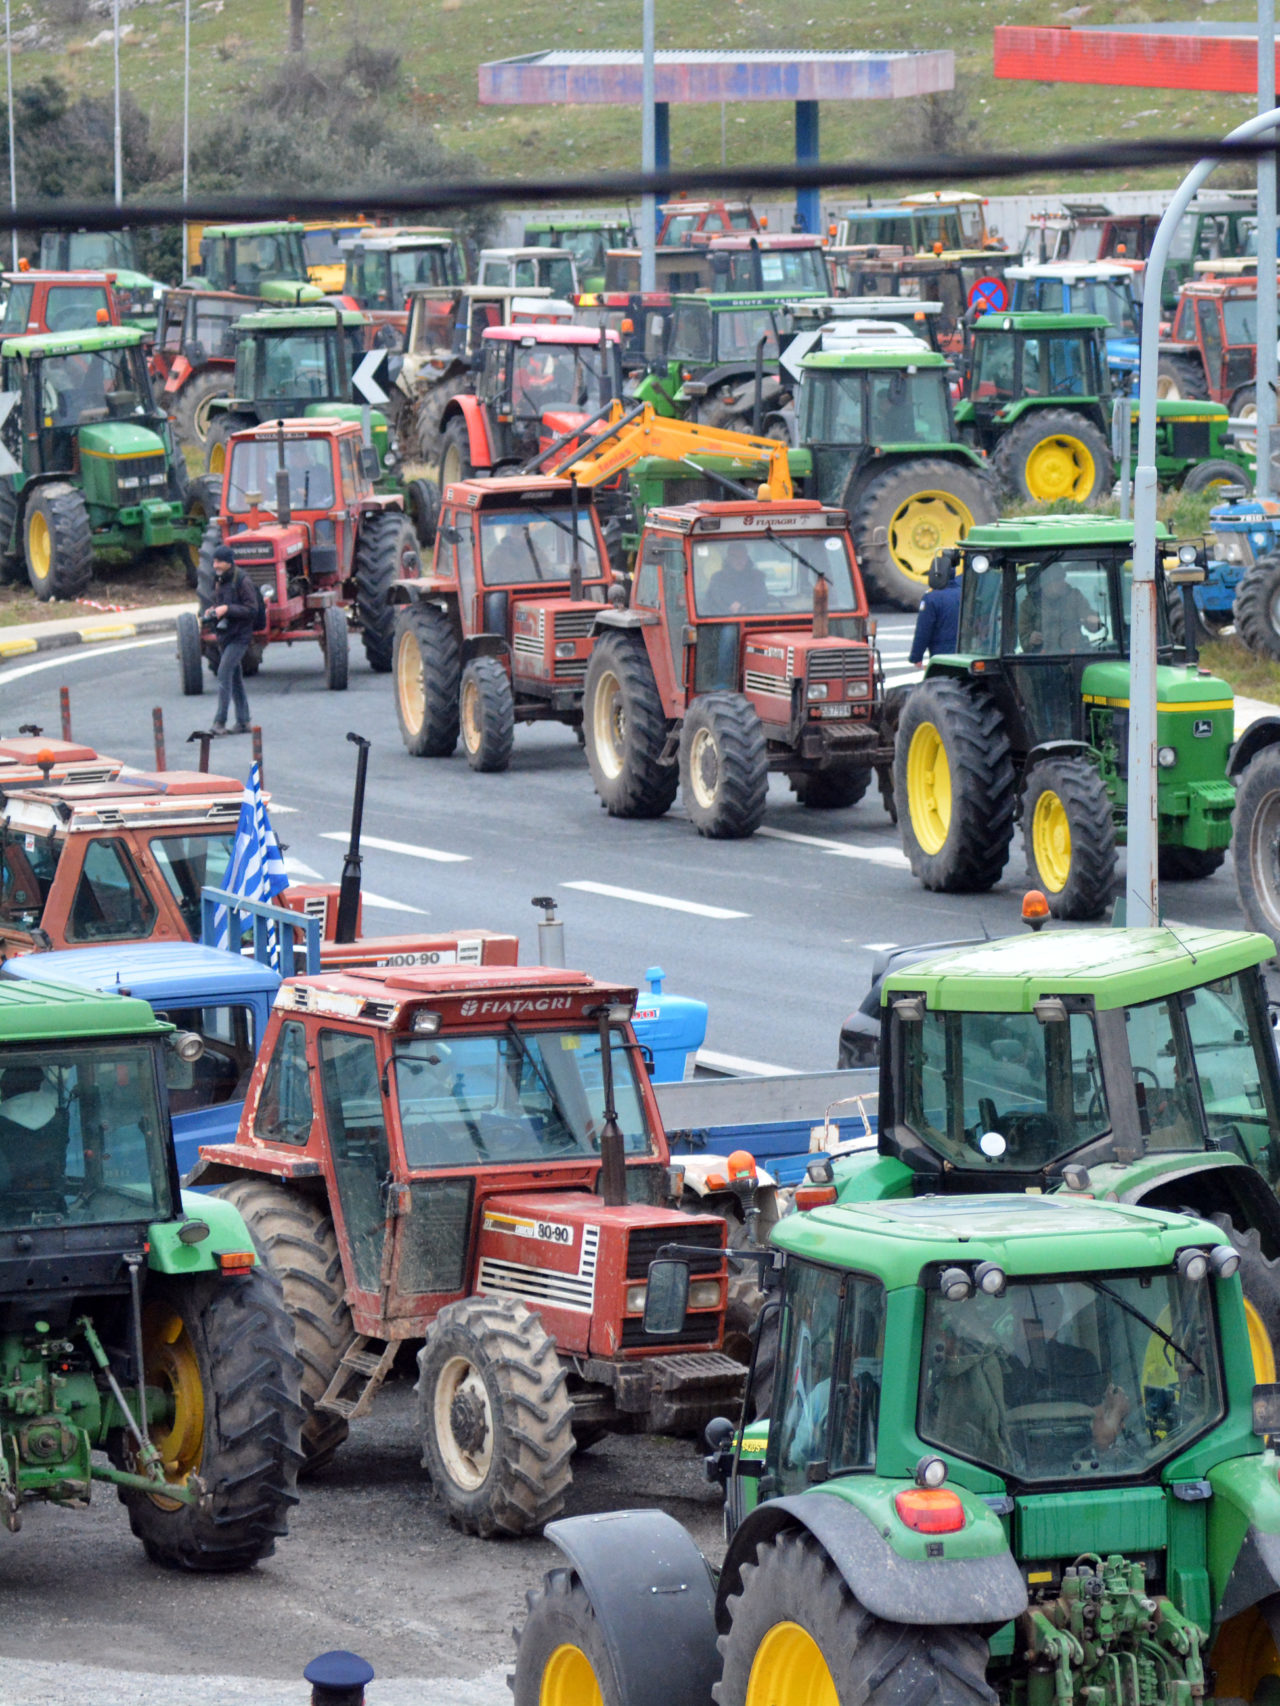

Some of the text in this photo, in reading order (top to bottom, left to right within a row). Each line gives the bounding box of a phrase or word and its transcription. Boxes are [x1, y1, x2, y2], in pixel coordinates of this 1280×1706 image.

[756, 518, 797, 526] FIATAGRI
[480, 997, 573, 1014] FIATAGRI
[538, 1223, 569, 1243] 80-90
